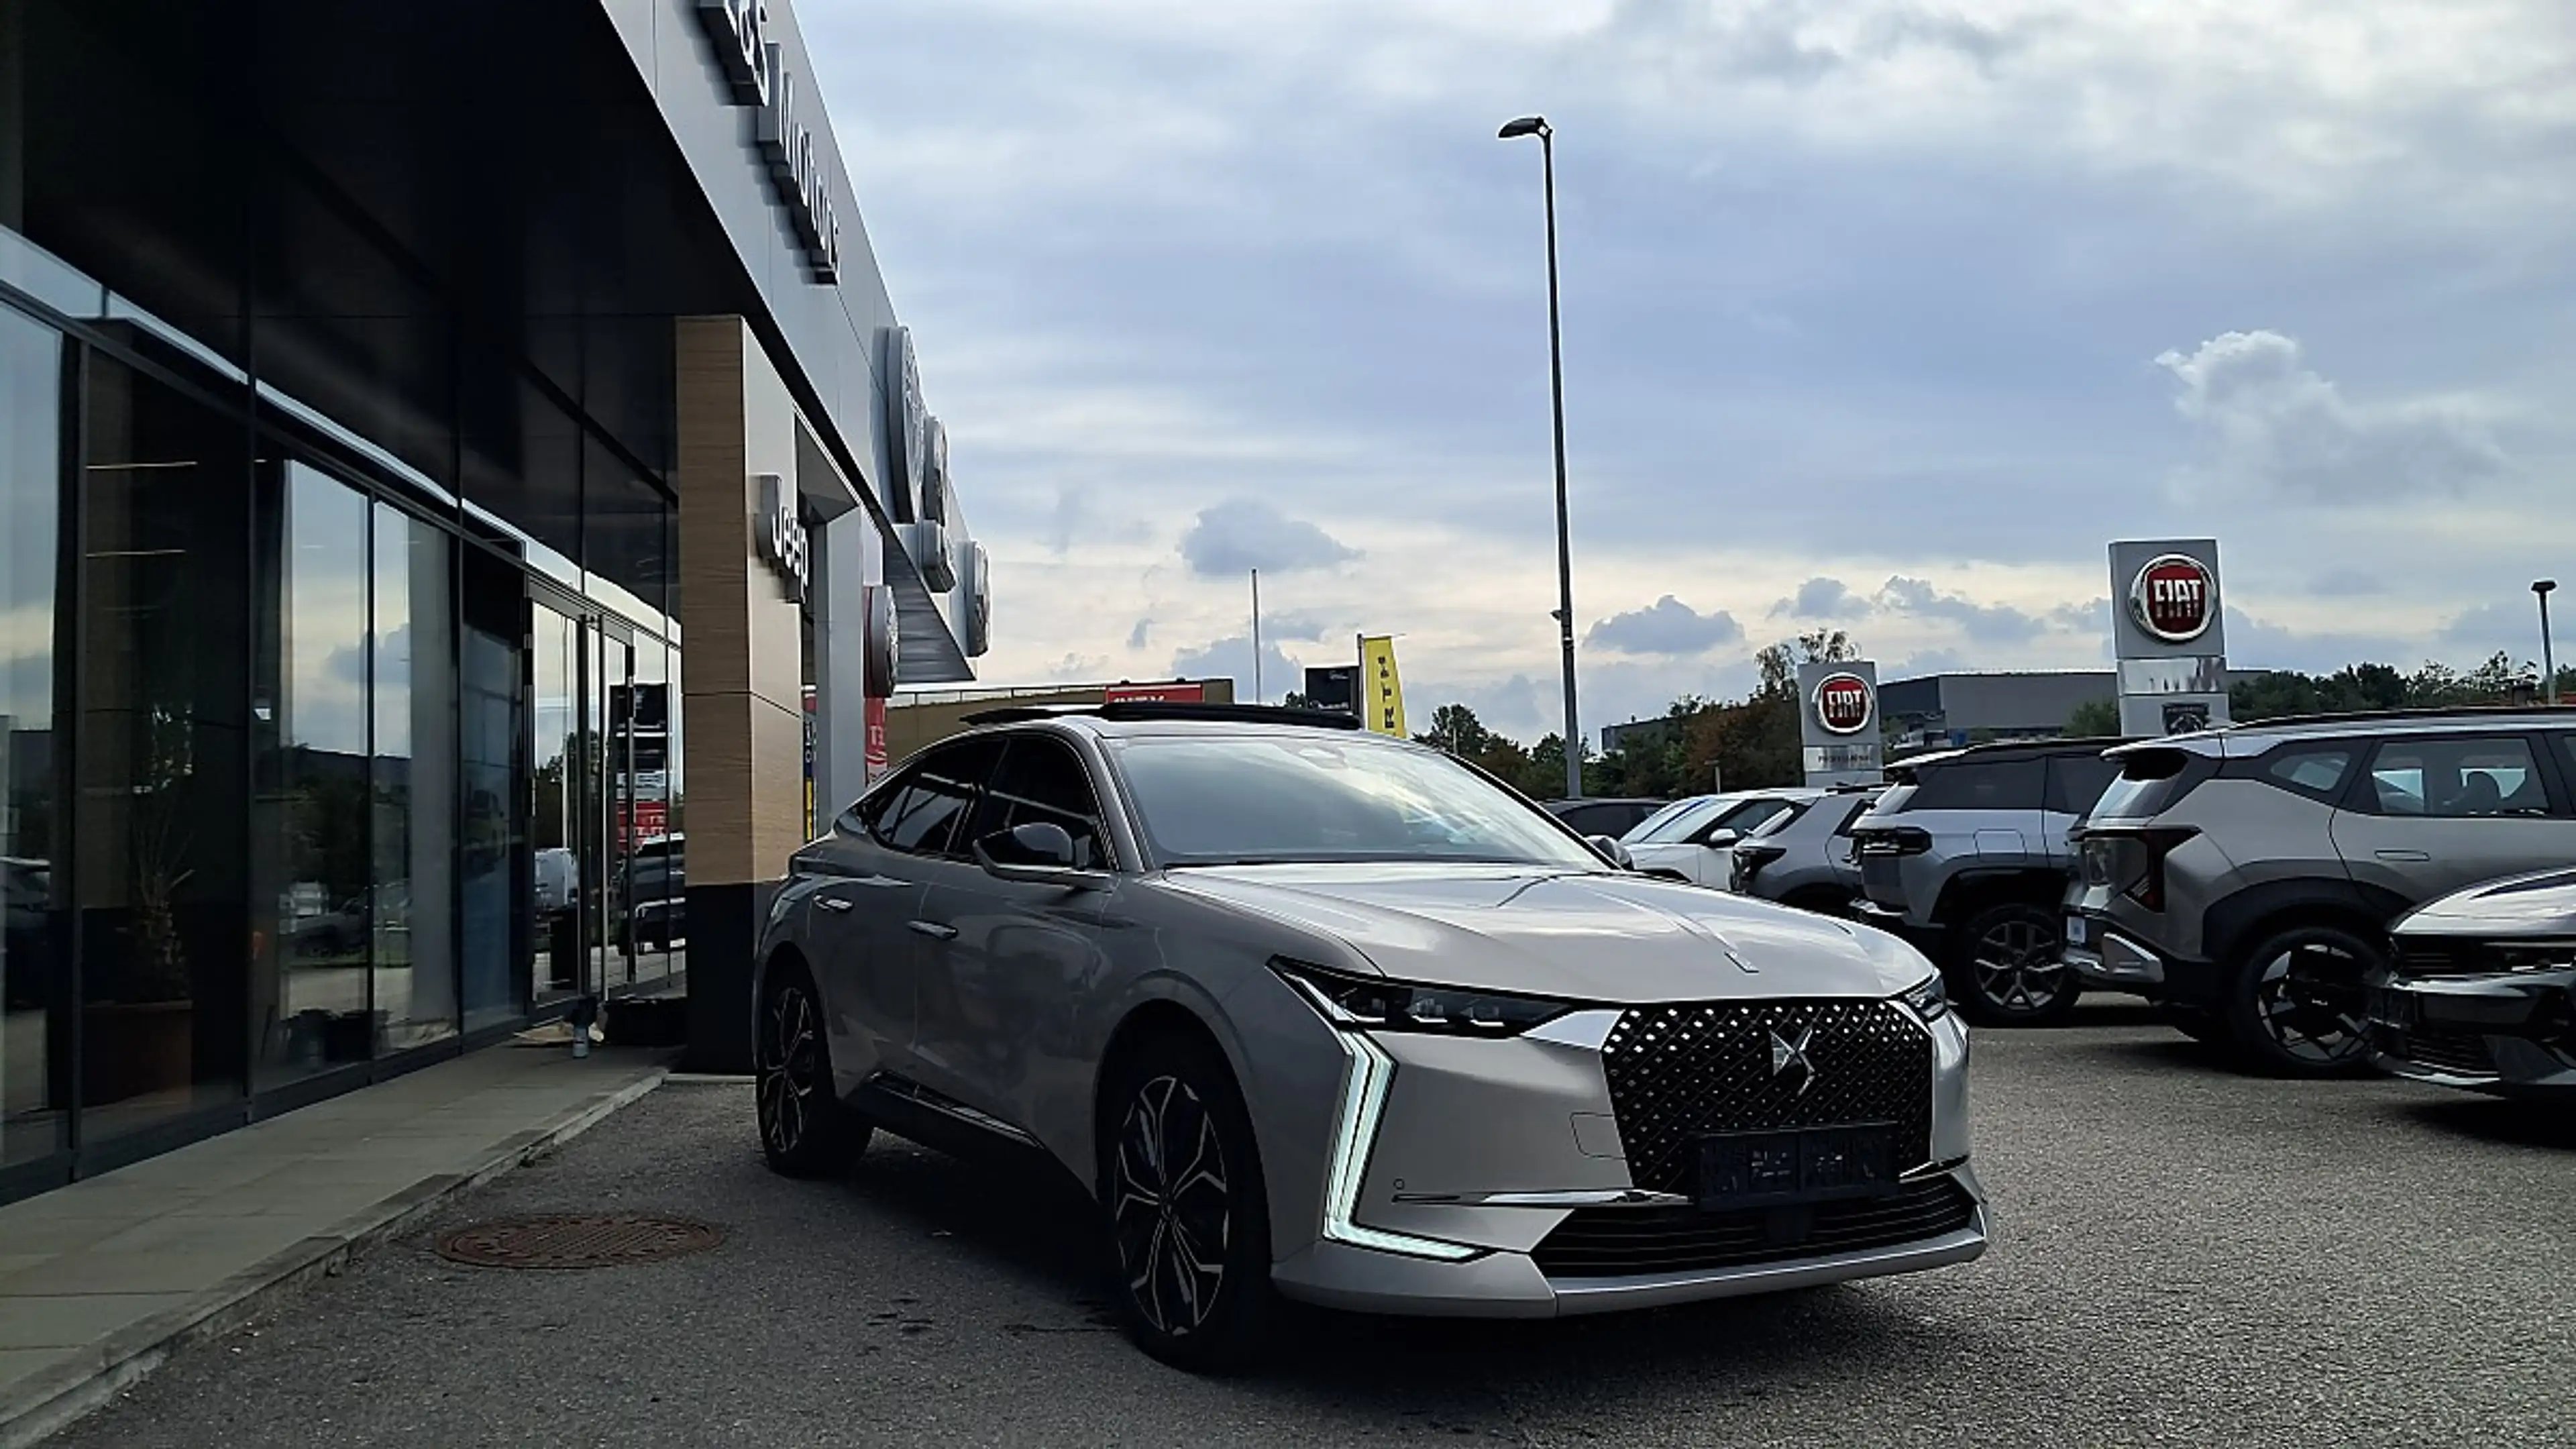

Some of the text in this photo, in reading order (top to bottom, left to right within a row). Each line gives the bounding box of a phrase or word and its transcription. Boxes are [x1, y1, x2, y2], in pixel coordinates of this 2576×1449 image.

[768, 476, 809, 604] Jeep
[2152, 579, 2202, 620] FIAT
[1826, 689, 1863, 718] FIAT
